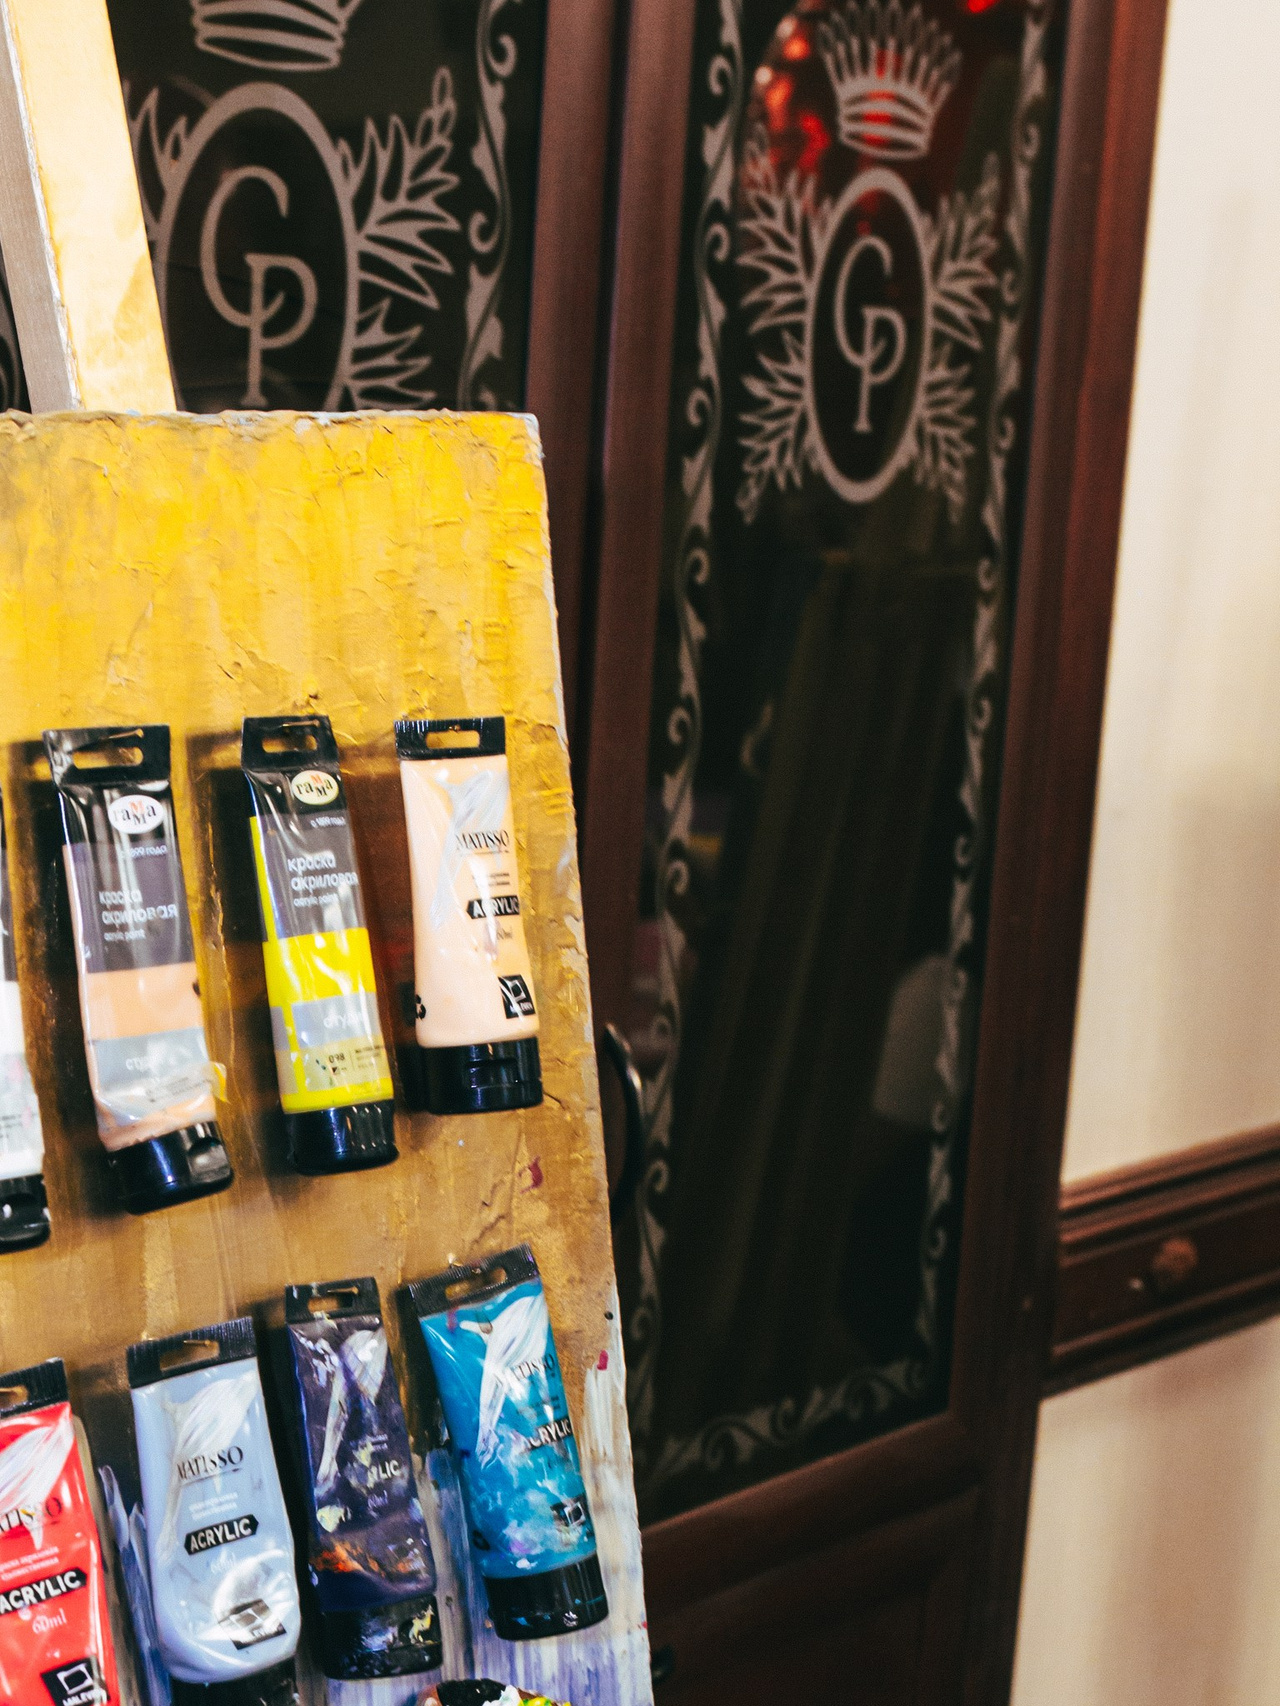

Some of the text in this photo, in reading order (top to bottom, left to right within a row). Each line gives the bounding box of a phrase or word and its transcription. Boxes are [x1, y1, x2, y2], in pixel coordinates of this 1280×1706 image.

[455, 829, 510, 850] MATISSO
[288, 854, 337, 877] краска
[176, 1445, 244, 1481] MATISSO
[190, 1517, 253, 1553] ACRYLIC
[32, 1607, 67, 1635] 60ml
